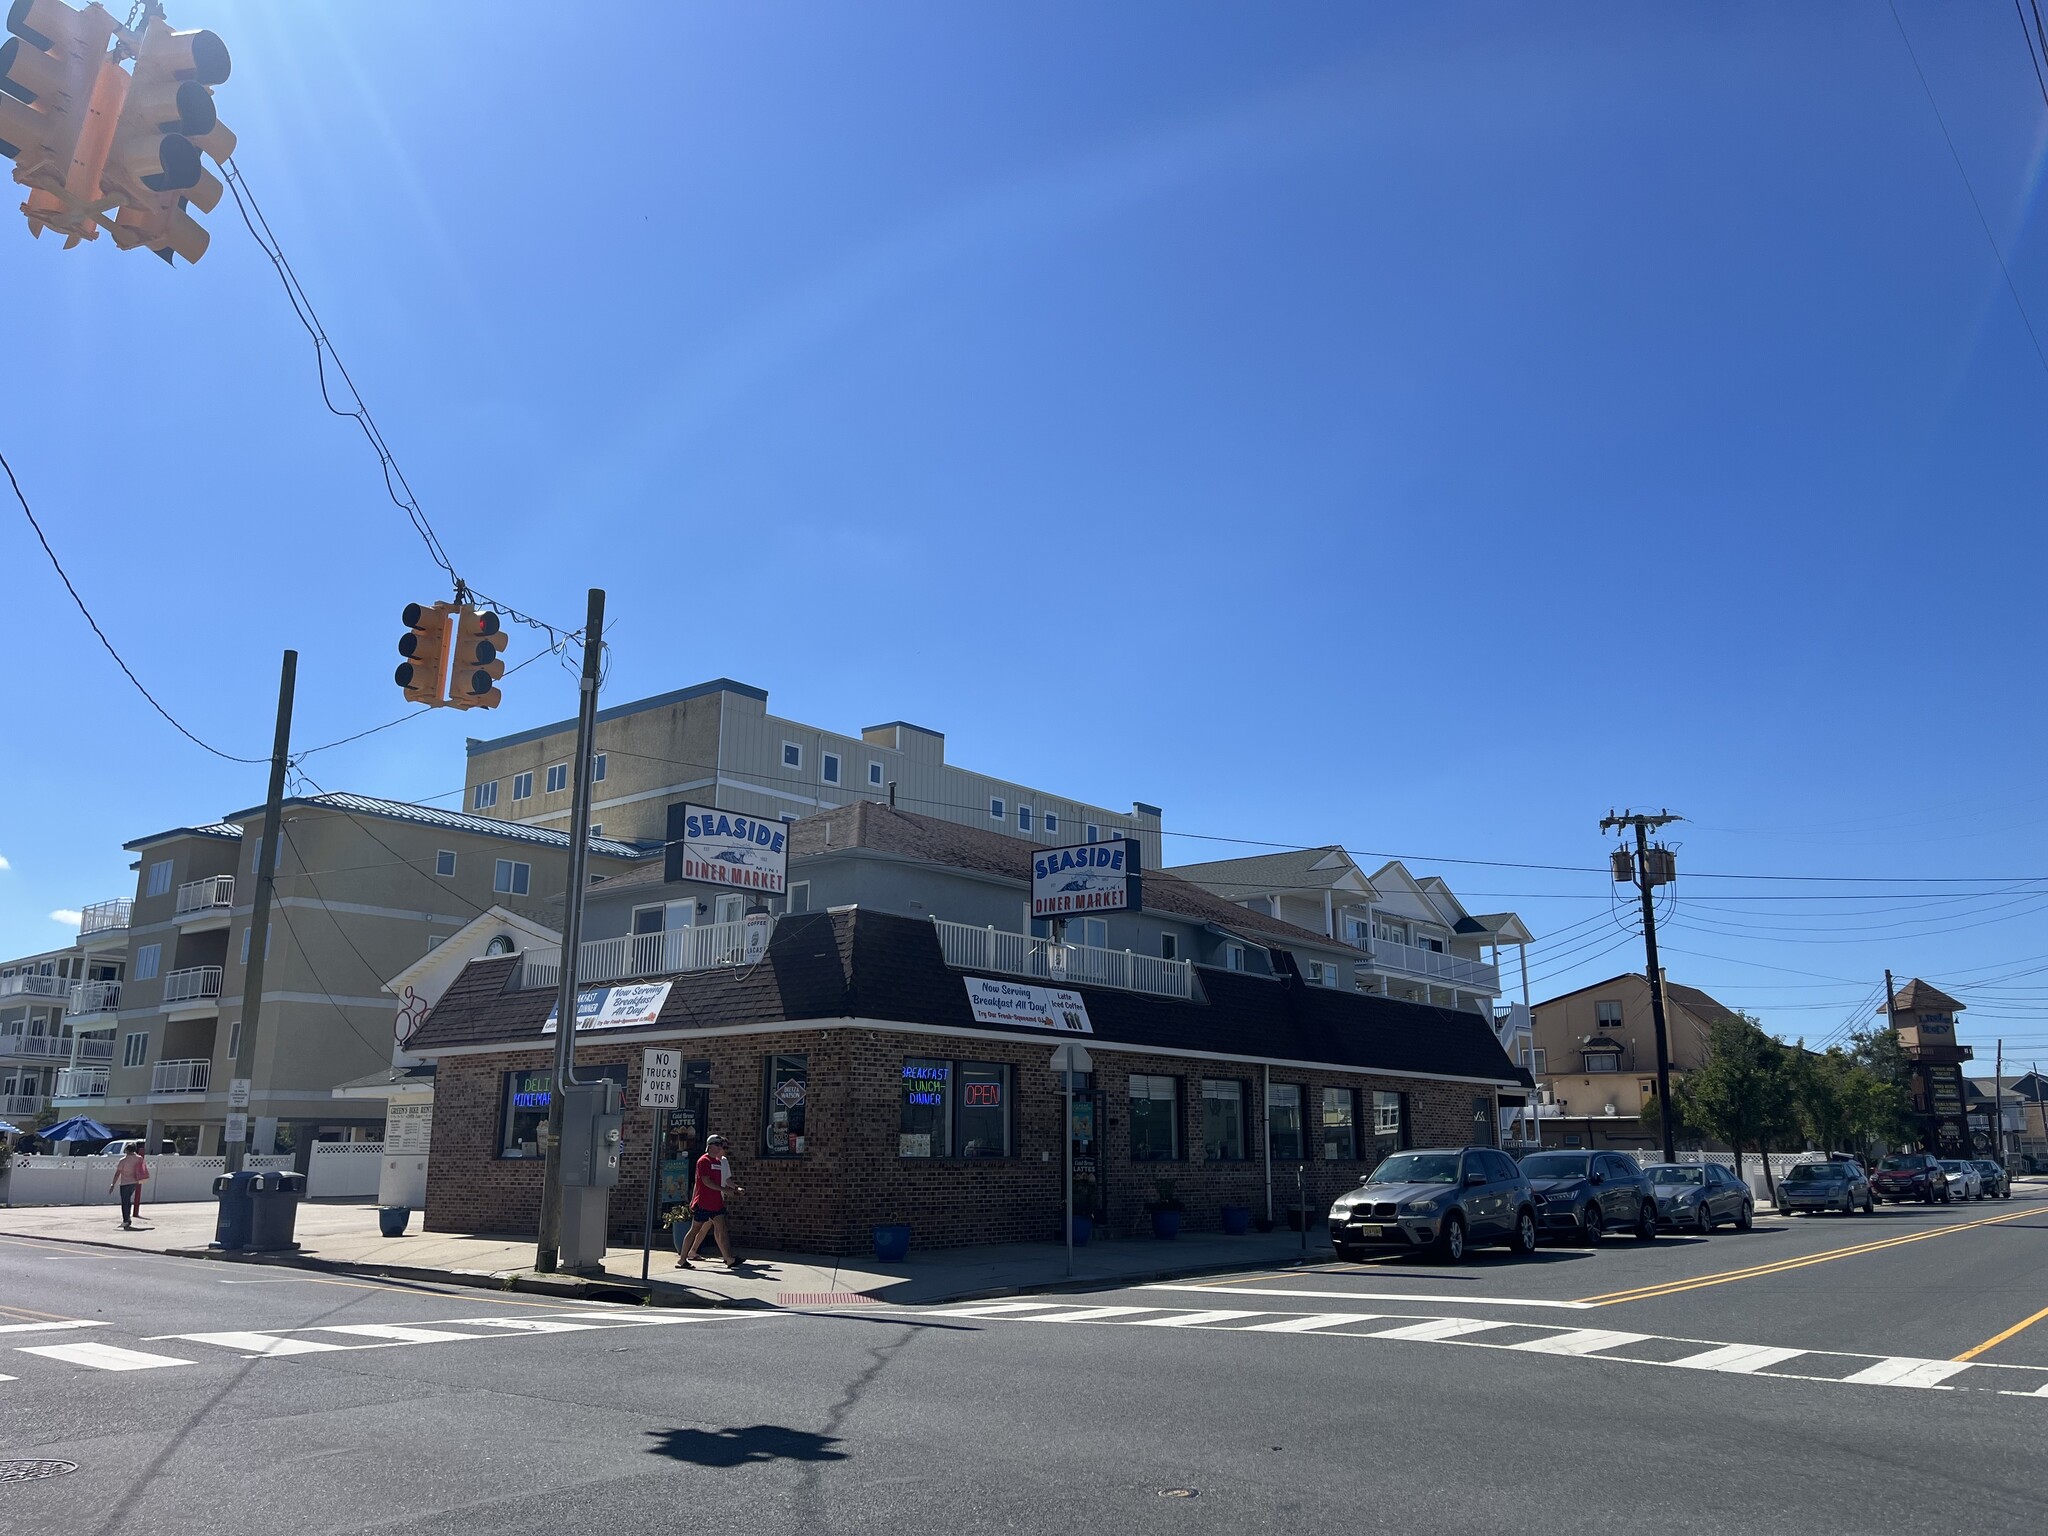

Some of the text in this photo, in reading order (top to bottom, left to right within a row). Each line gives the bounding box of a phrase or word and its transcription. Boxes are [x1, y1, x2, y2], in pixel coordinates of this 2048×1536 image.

[686, 815, 785, 854] SEASIDE
[1035, 848, 1125, 879] SEASIDE
[685, 860, 783, 890] DINER MARKET
[1036, 890, 1124, 913] DINER MARKET
[613, 986, 664, 997] Now Serving
[982, 982, 1031, 999] Now Serving
[1057, 992, 1072, 1001] Latte
[577, 992, 598, 1003] AKFAST
[613, 994, 656, 1007] Breakfast
[611, 1005, 648, 1016] All Day!
[972, 995, 1047, 1014] Breakfast All Day!
[1052, 1001, 1084, 1011] Iced Coffee
[977, 1010, 987, 1018] Try
[656, 1053, 669, 1065] NO
[646, 1067, 677, 1078] TRUCKS
[902, 1066, 950, 1081] BREAKFAST
[524, 1077, 551, 1092] DELI
[650, 1080, 671, 1090] OVER
[644, 1093, 675, 1104] 4 TONS
[909, 1092, 941, 1105] DINNER
[966, 1085, 999, 1105] OPEN
